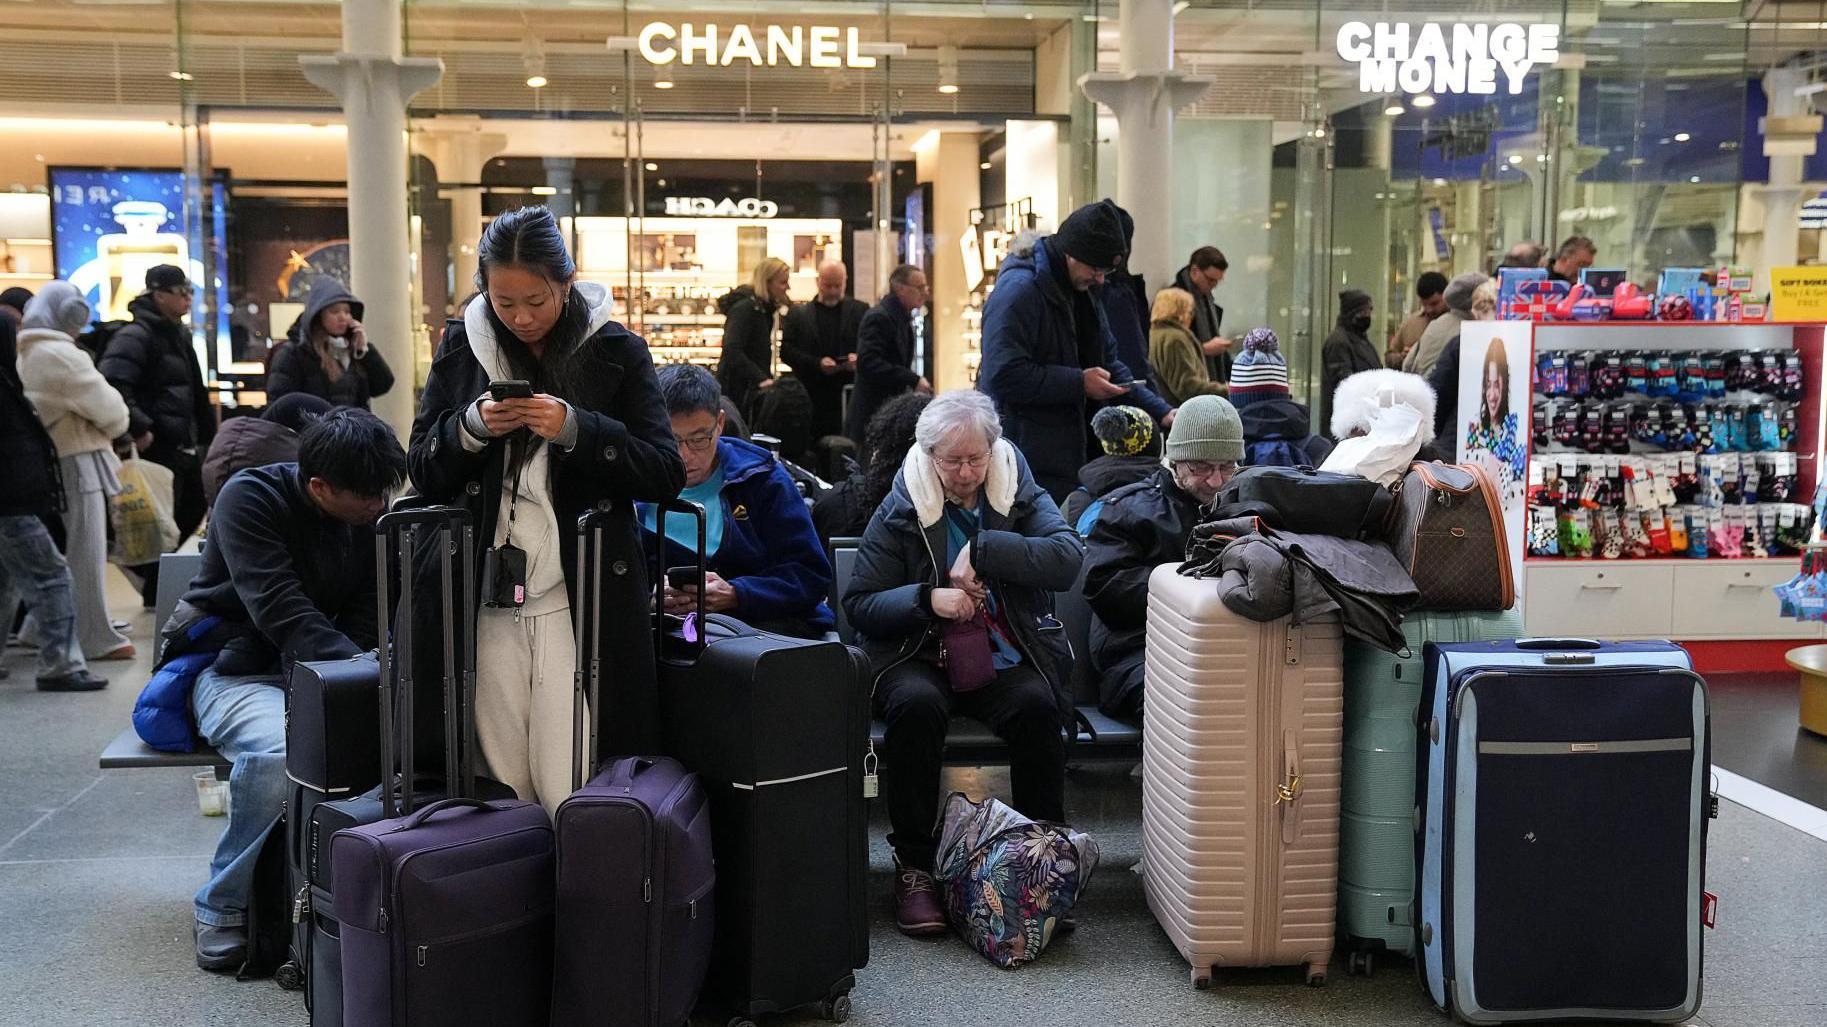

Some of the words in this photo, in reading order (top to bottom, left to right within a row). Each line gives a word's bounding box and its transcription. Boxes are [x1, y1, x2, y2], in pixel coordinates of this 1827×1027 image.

[638, 21, 876, 68] CHANEL
[1336, 21, 1560, 63] CHANGE
[1359, 56, 1535, 95] MONEY
